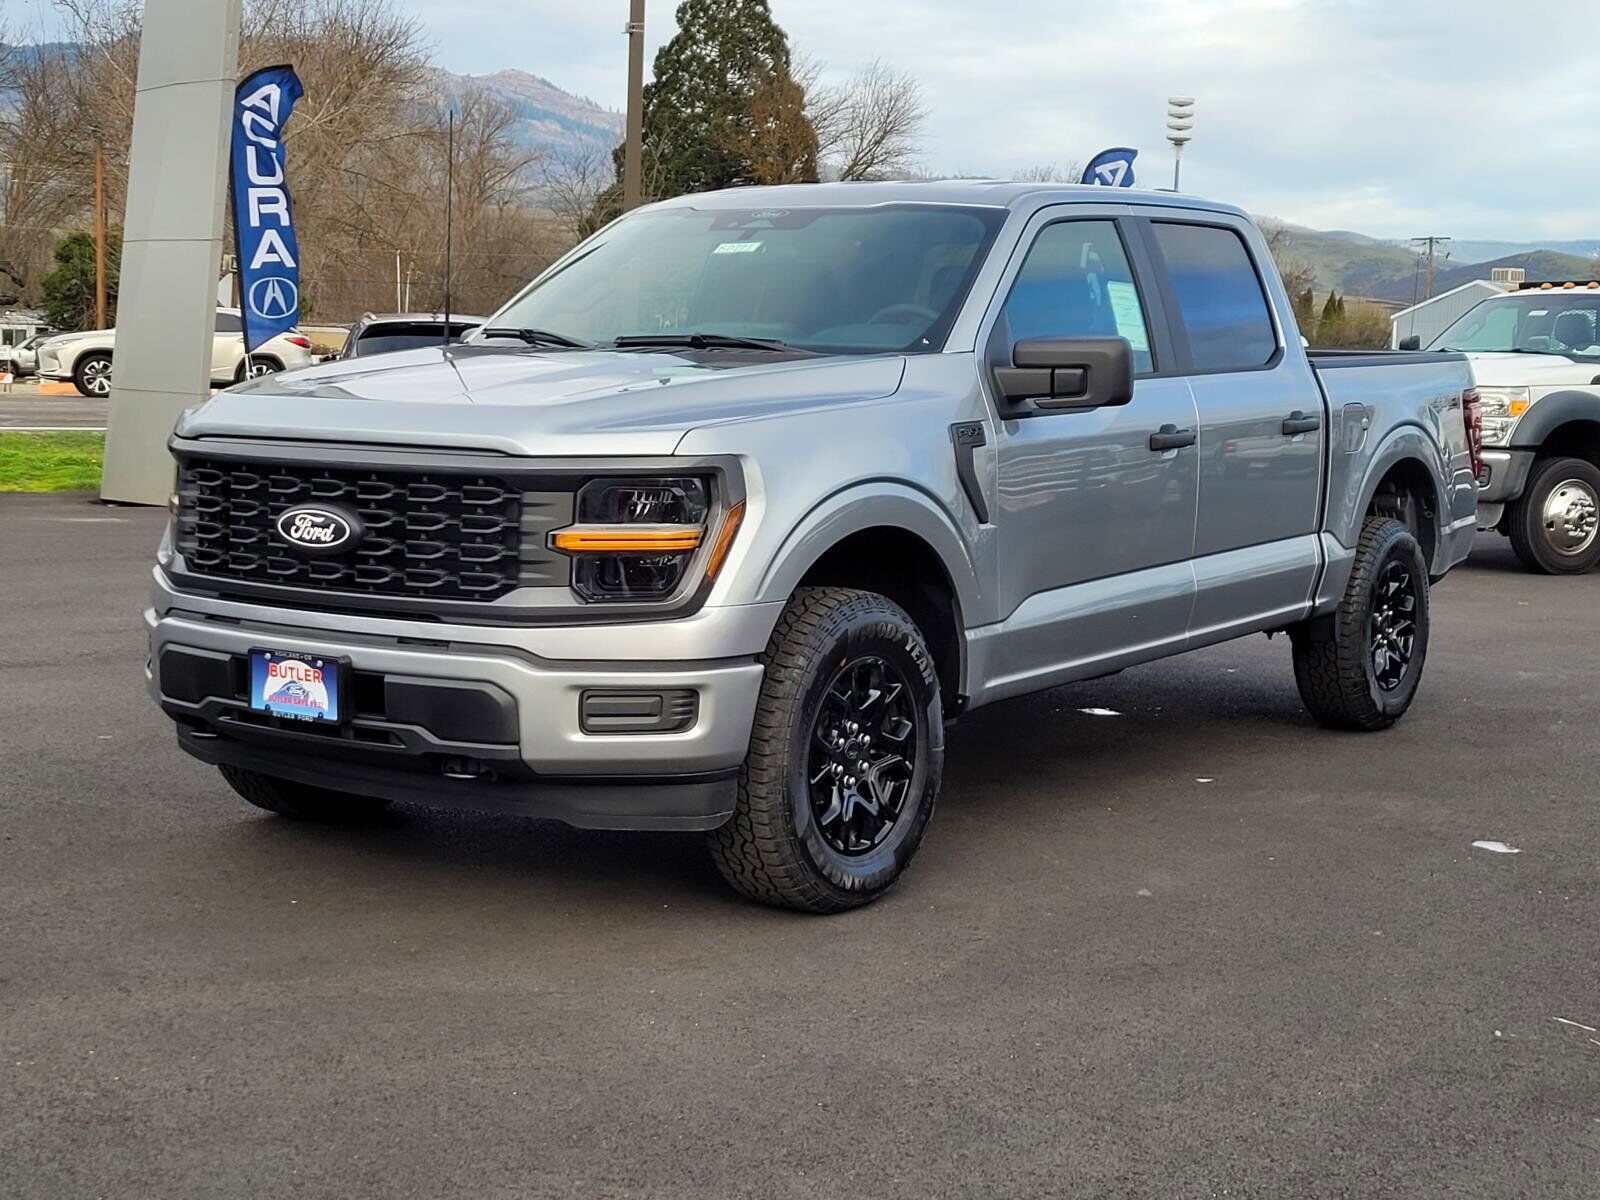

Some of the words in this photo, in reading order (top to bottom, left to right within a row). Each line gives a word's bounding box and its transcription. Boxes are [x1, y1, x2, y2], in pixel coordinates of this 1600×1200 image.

[240, 83, 297, 269] ACURA
[290, 514, 336, 542] Ford
[269, 664, 322, 683] BUTLER
